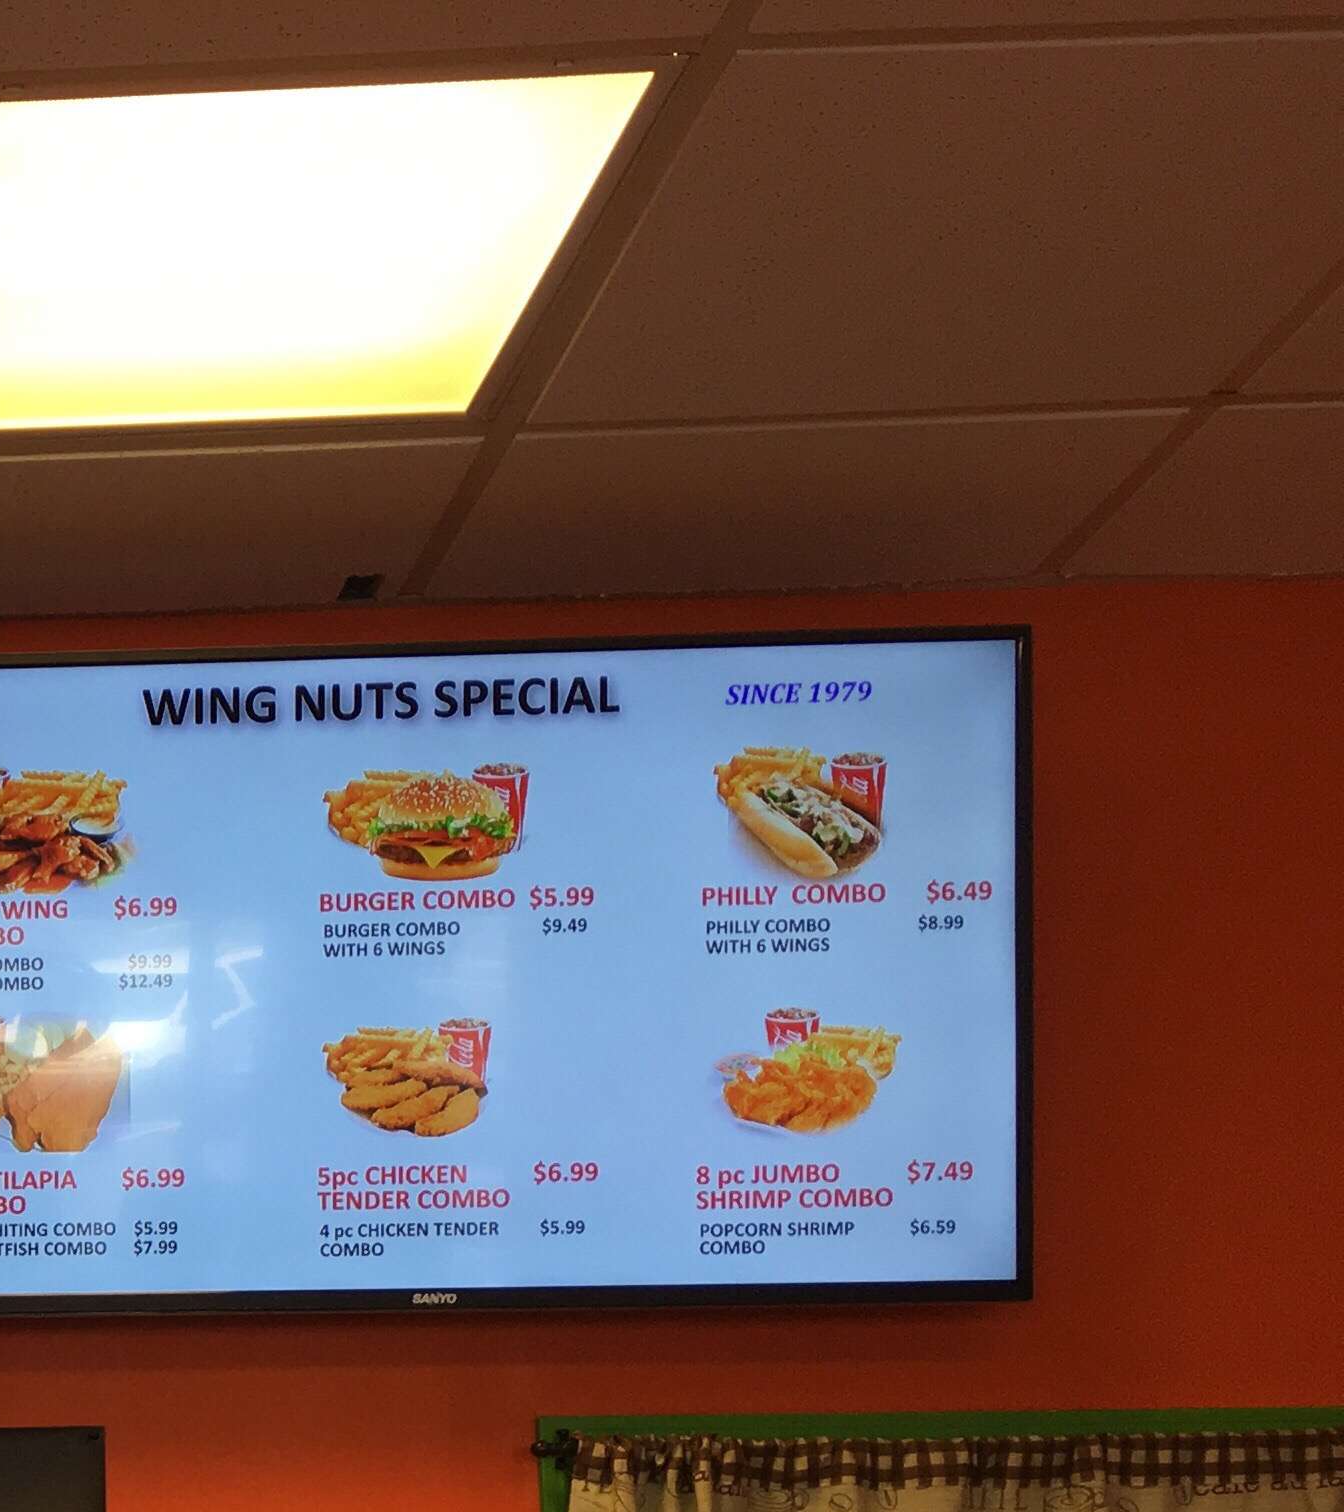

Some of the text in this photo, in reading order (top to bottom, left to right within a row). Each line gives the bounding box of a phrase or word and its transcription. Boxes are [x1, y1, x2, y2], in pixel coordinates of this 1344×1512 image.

[143, 677, 620, 725] WING NUTS SPECIAL
[725, 681, 872, 705] SINCE 1979
[703, 880, 992, 906] PHILLY COMBO $6.49
[1, 900, 67, 919] WING
[115, 896, 177, 920] $6.99
[121, 1167, 185, 1191] $6.99
[697, 1160, 973, 1189] 8 pc JUMBO $7.49
[697, 1188, 893, 1209] SHRIMP COMBO
[701, 1219, 956, 1237] POPCORN SHRIMP $6.59
[413, 1293, 457, 1303] SANYO
